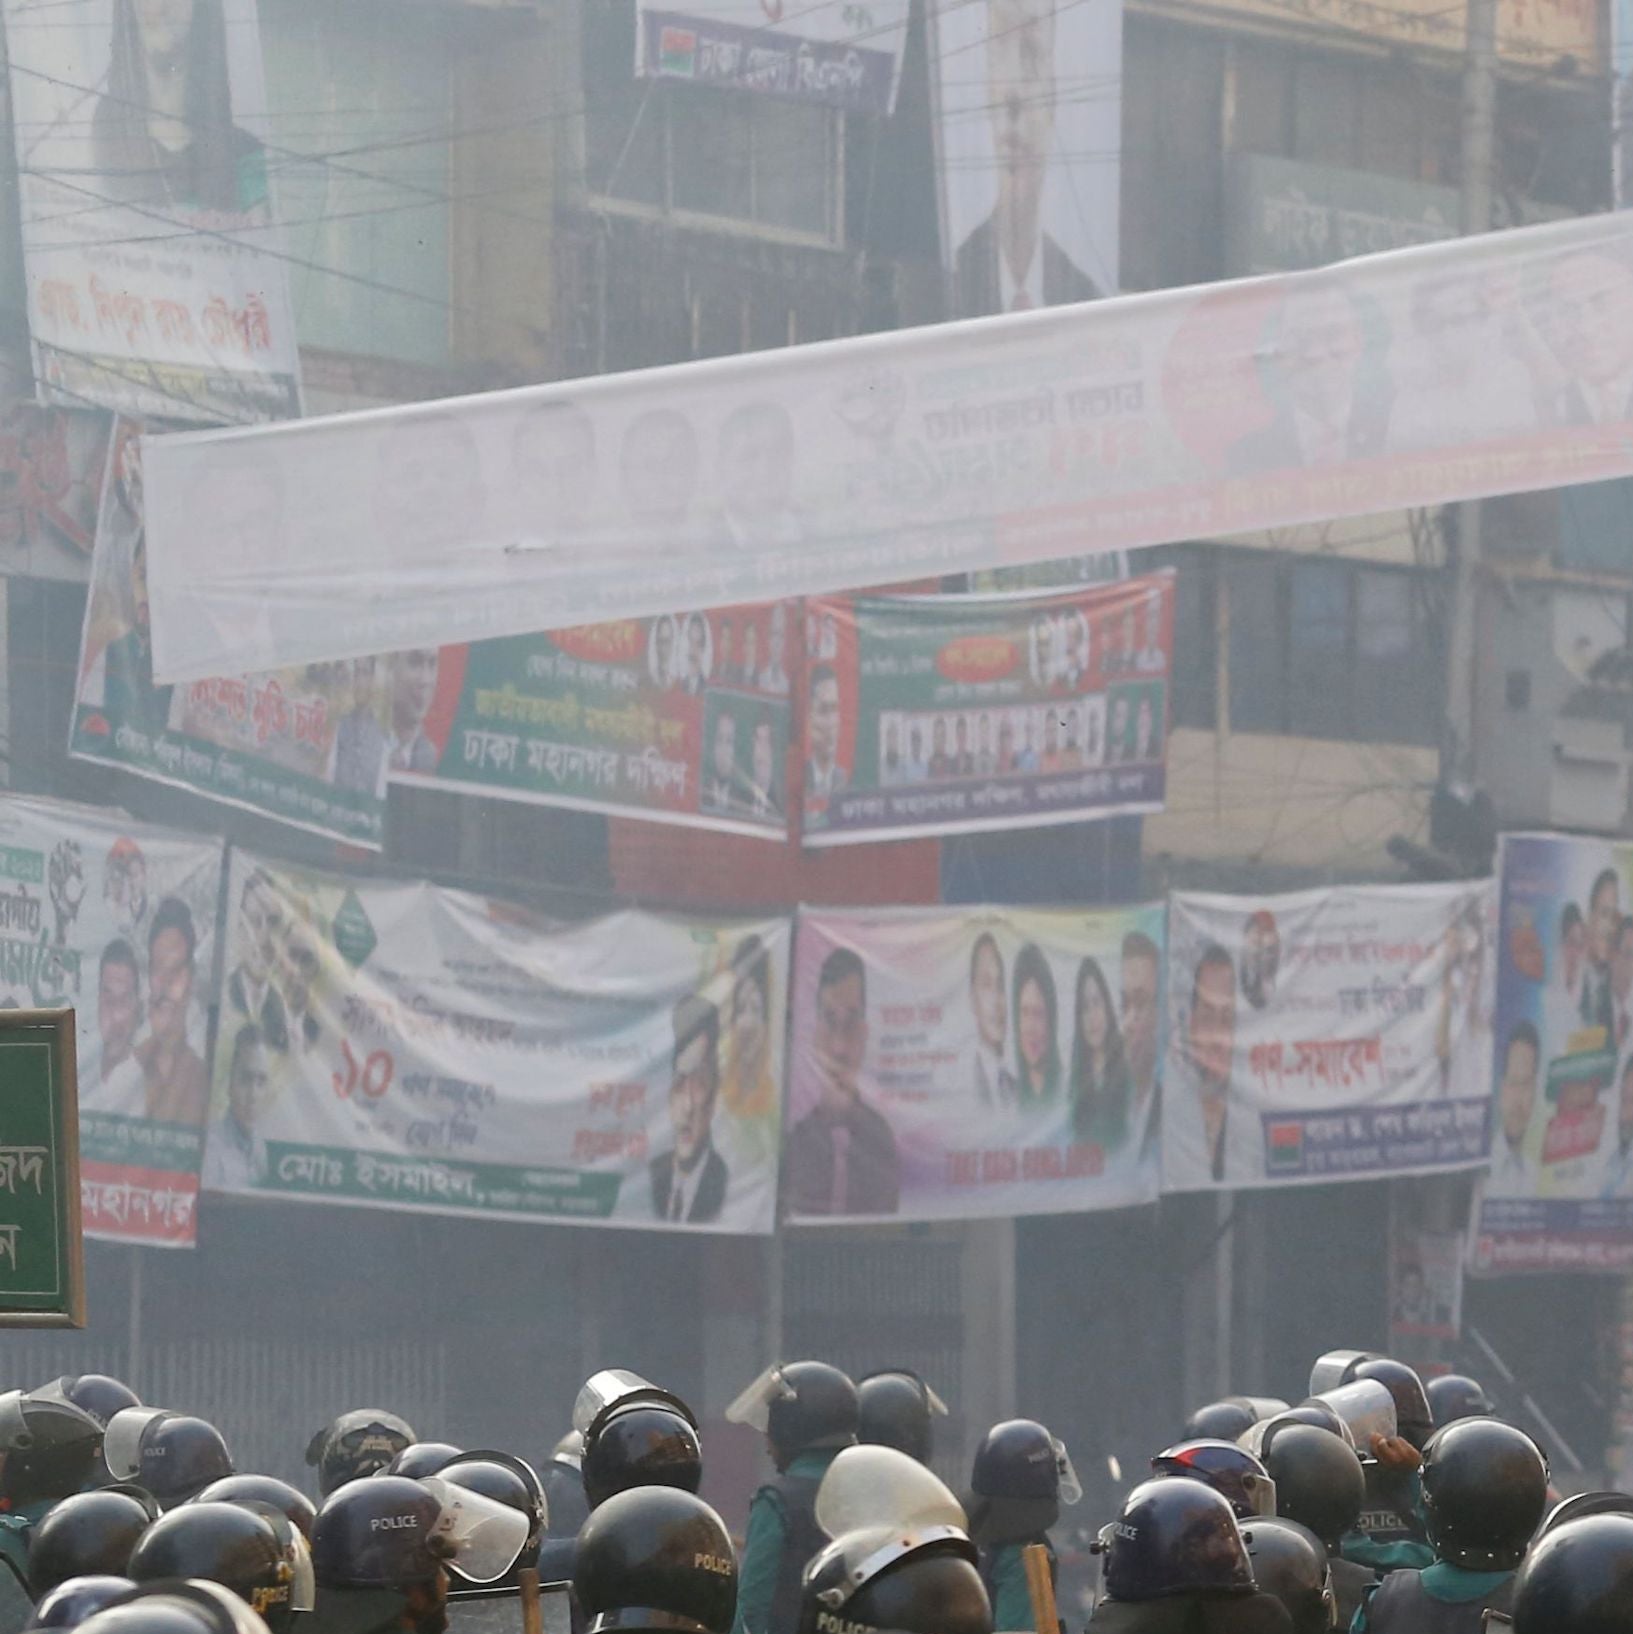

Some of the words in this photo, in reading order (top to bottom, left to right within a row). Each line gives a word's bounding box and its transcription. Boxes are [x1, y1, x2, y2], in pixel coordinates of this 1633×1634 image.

[464, 729, 520, 773] ঢাকা
[526, 739, 620, 791] মহানগর
[624, 745, 689, 800] দক্ষিণ
[332, 1039, 396, 1101] ১০
[279, 1152, 345, 1187] মোঃ
[81, 1178, 197, 1229] মহানগর
[370, 1514, 419, 1533] POLICE
[694, 1552, 733, 1577] POLICE
